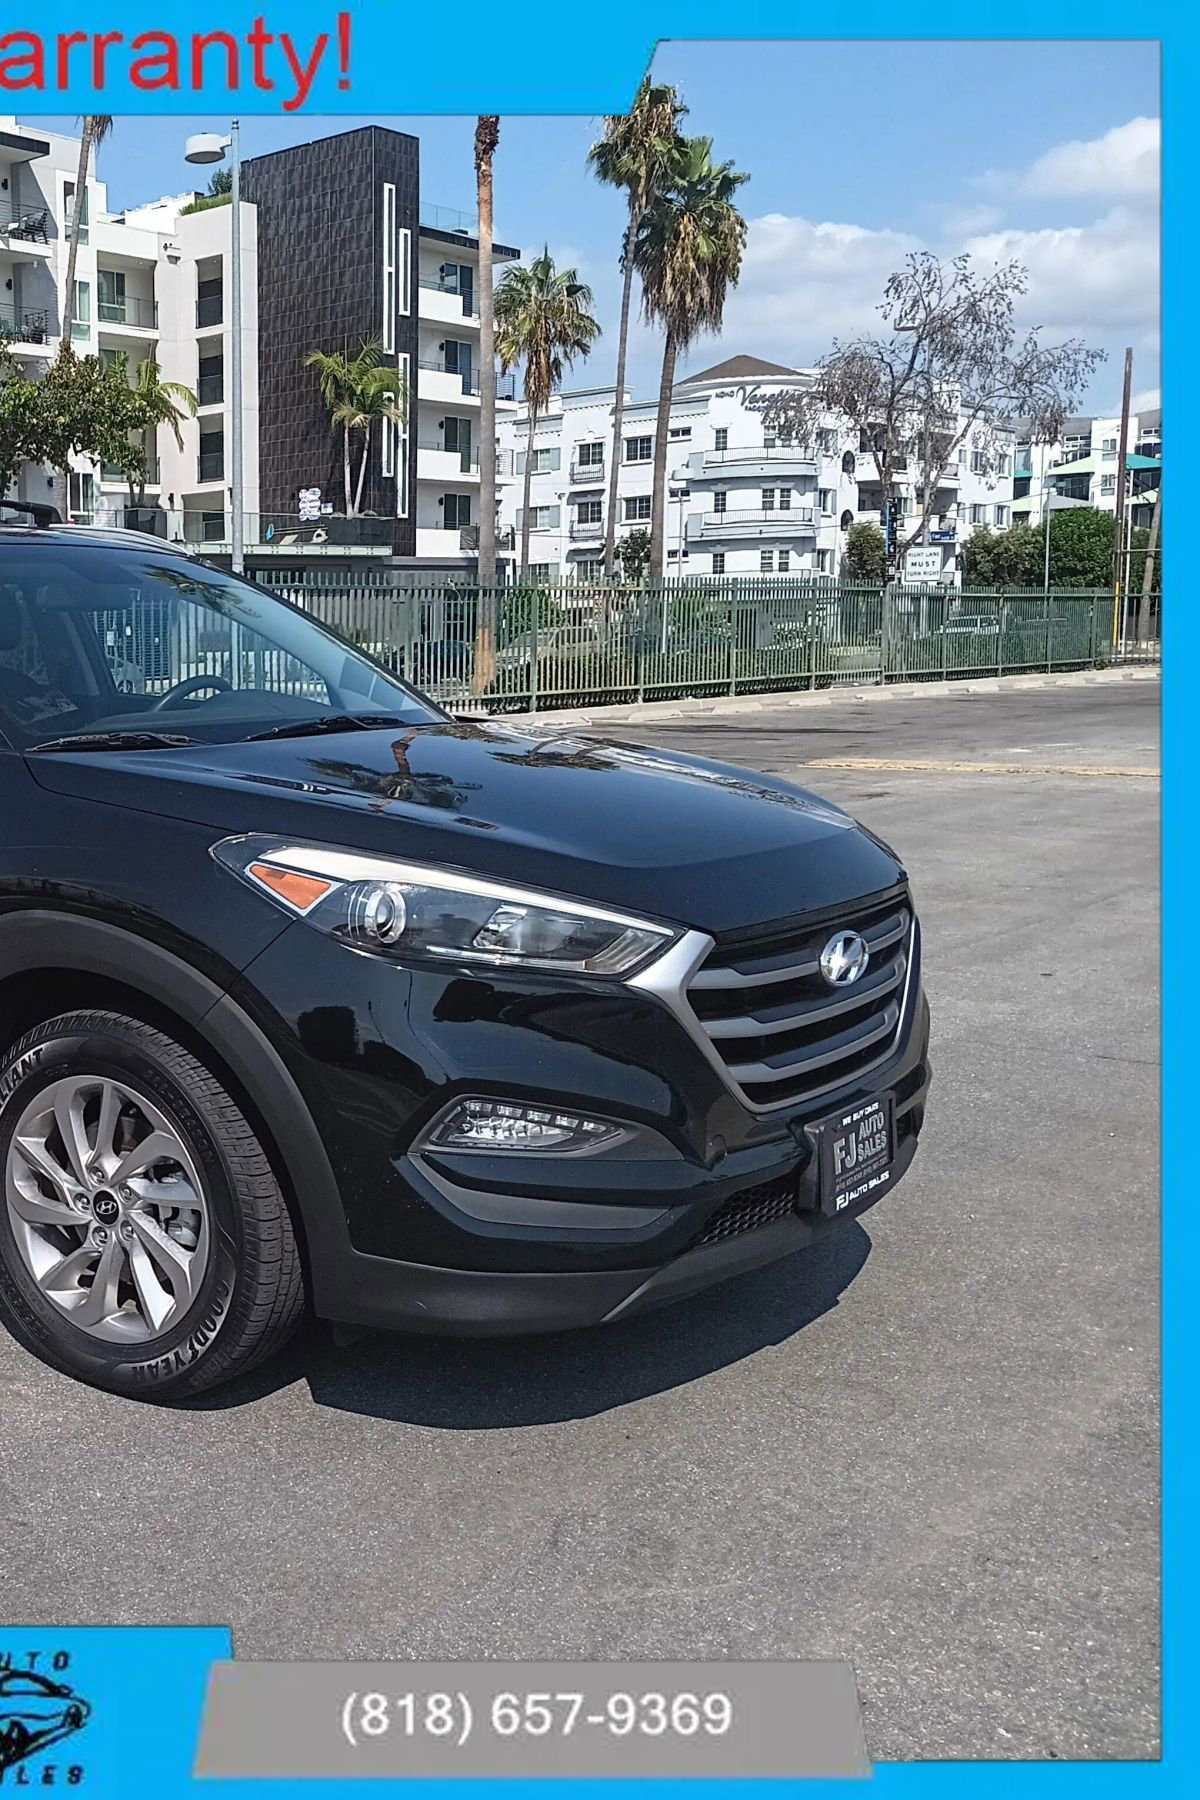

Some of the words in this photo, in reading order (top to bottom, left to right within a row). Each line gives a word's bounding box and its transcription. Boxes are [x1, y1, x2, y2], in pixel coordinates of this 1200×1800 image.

[911, 560, 936, 568] MUST
[859, 1111, 885, 1141] AUTO
[833, 1132, 857, 1175] FJ
[857, 1130, 887, 1162] SALES
[836, 1192, 850, 1211] FJ
[849, 1183, 868, 1201] AUTO
[868, 1170, 890, 1189] SALES
